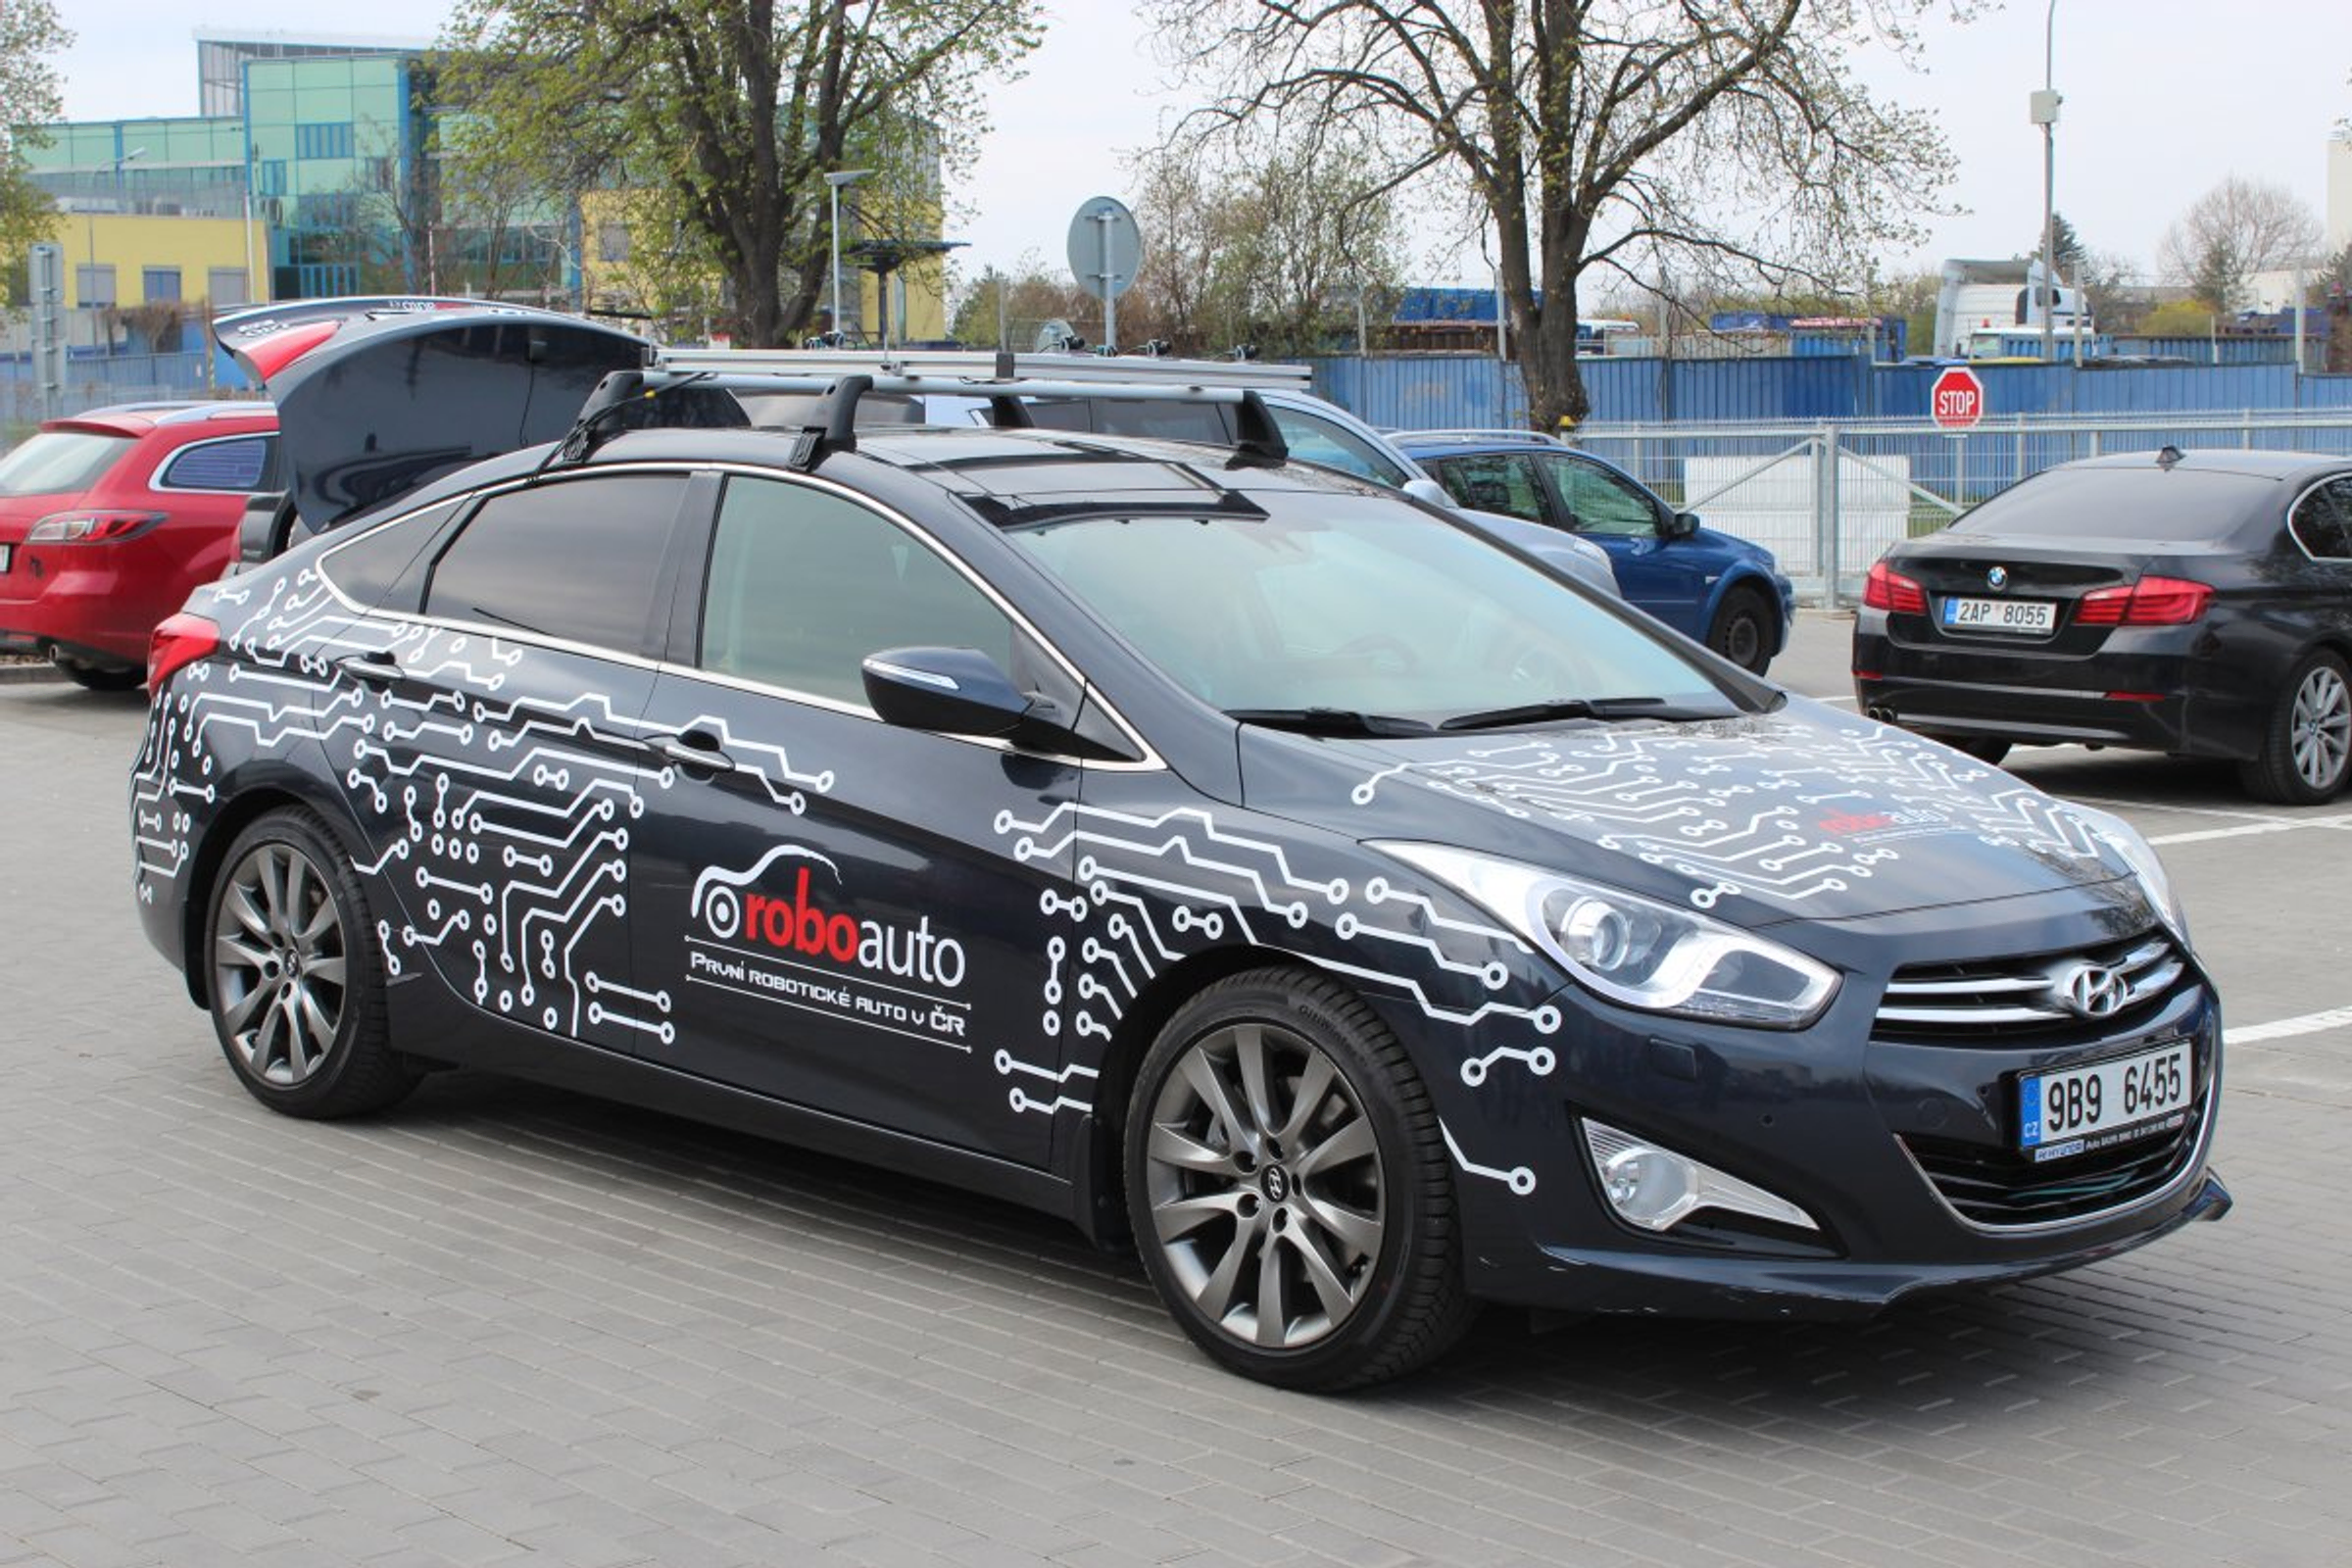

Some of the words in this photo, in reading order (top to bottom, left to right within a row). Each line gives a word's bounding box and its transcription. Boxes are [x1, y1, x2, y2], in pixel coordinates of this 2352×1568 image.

[1938, 390, 1976, 415] STOP
[1958, 602, 1990, 622] 2AP
[2003, 604, 2047, 625] 8055
[746, 866, 966, 988] roboauto
[930, 1004, 965, 1036] ČR
[2048, 1074, 2102, 1132] 9B9
[2124, 1053, 2181, 1114] 6455
[2024, 1121, 2039, 1139] CZ
